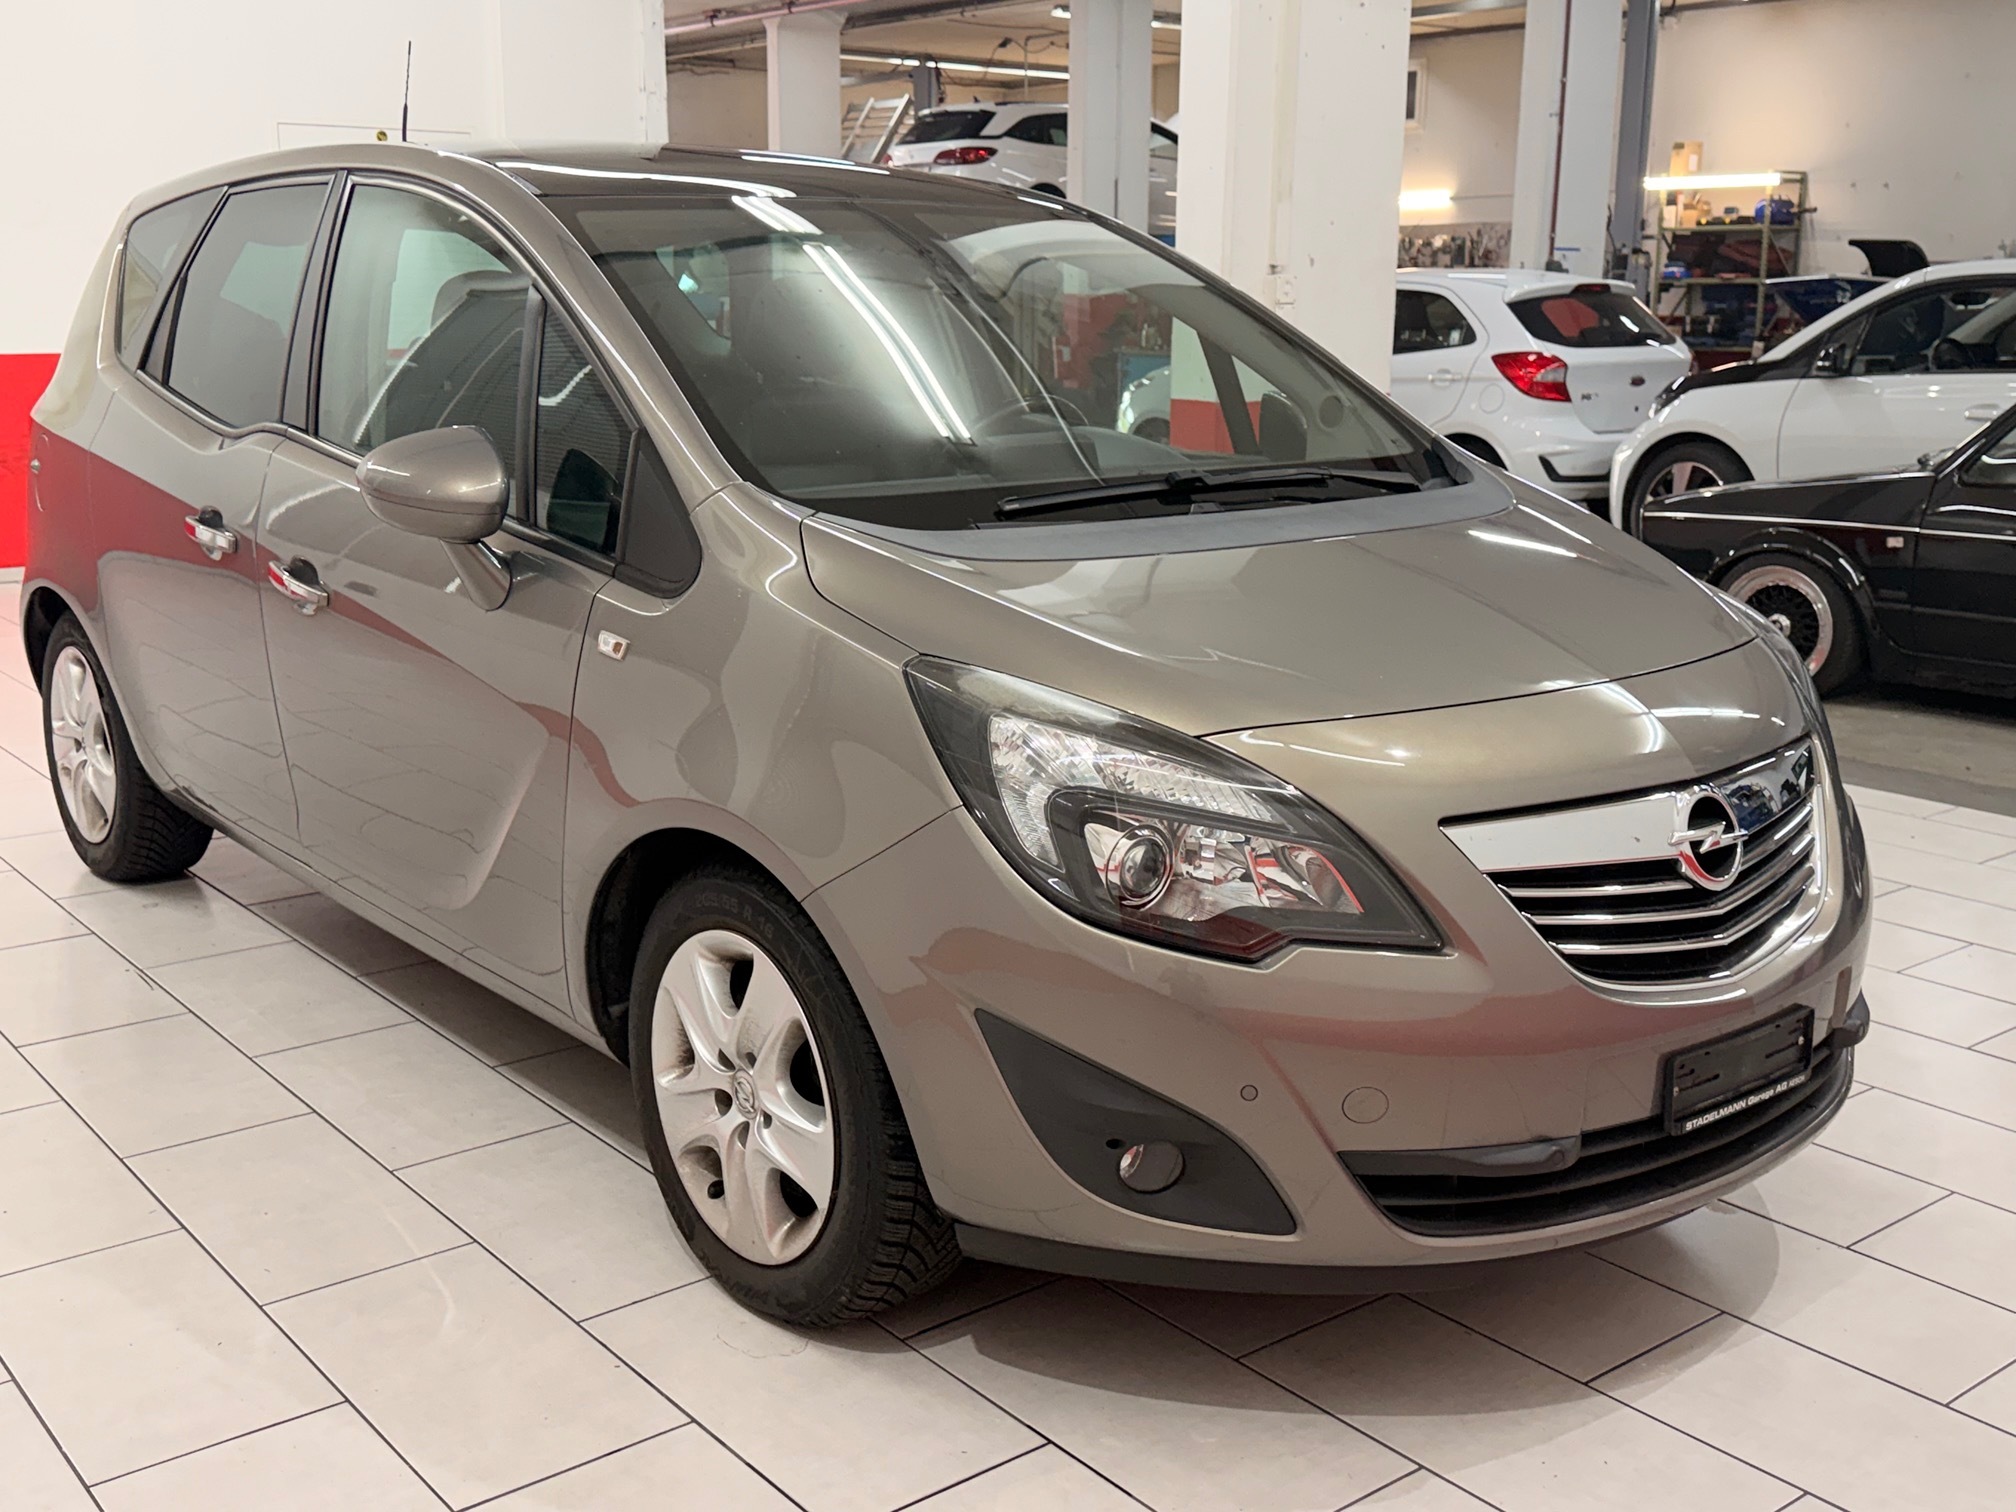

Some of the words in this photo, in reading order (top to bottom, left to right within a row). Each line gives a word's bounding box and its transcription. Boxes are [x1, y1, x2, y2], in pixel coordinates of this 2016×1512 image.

[1685, 1099, 1747, 1131] STADELMANN
[1747, 1089, 1775, 1106] Garage
[1775, 1081, 1788, 1094] AG
